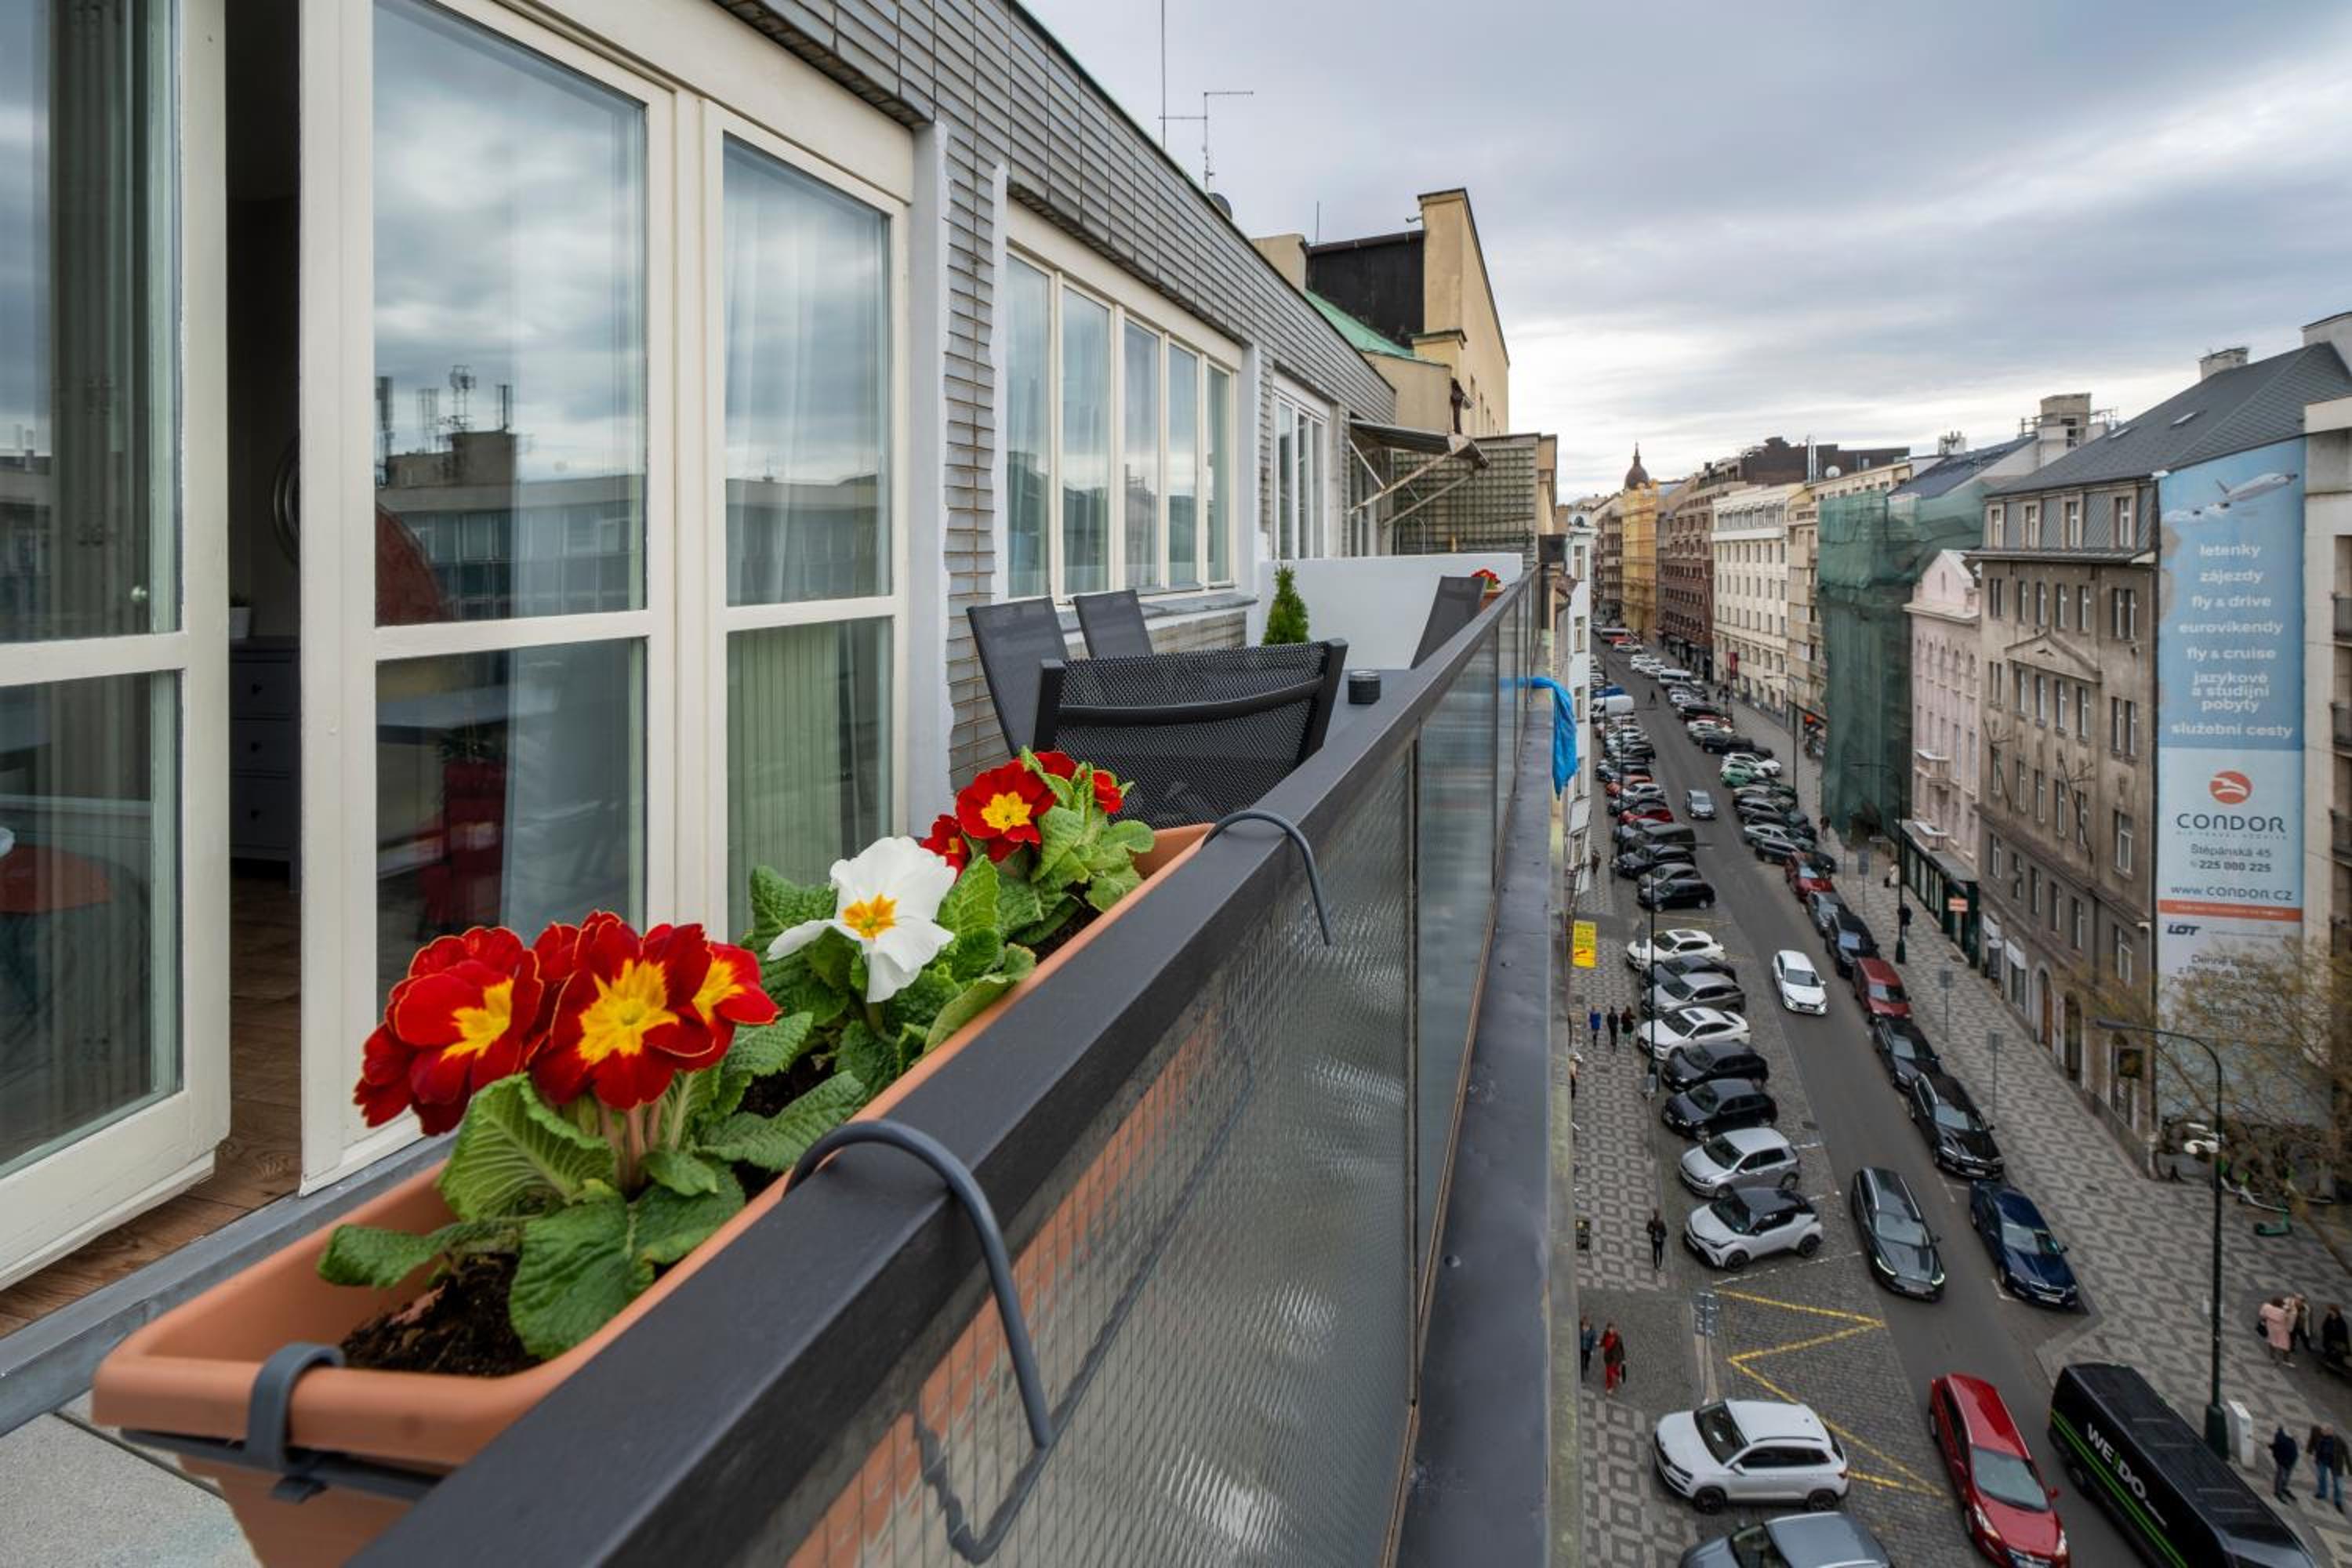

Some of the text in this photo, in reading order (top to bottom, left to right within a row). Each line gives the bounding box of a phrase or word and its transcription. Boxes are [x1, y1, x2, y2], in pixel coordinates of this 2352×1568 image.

[2200, 543, 2261, 558] letenky
[2199, 569, 2263, 585] zájezdy
[2191, 594, 2271, 611] fly & drive
[2186, 646, 2276, 662] fly & cruise
[2193, 671, 2269, 686] jazykové
[2192, 685, 2270, 699] a studijní
[2201, 699, 2259, 713] pobyty
[2170, 721, 2293, 739] služební cesty
[2176, 813, 2285, 833] CONDOR
[2199, 860, 2221, 869] 225
[2249, 863, 2271, 873] 225
[2167, 924, 2201, 936] LOT
